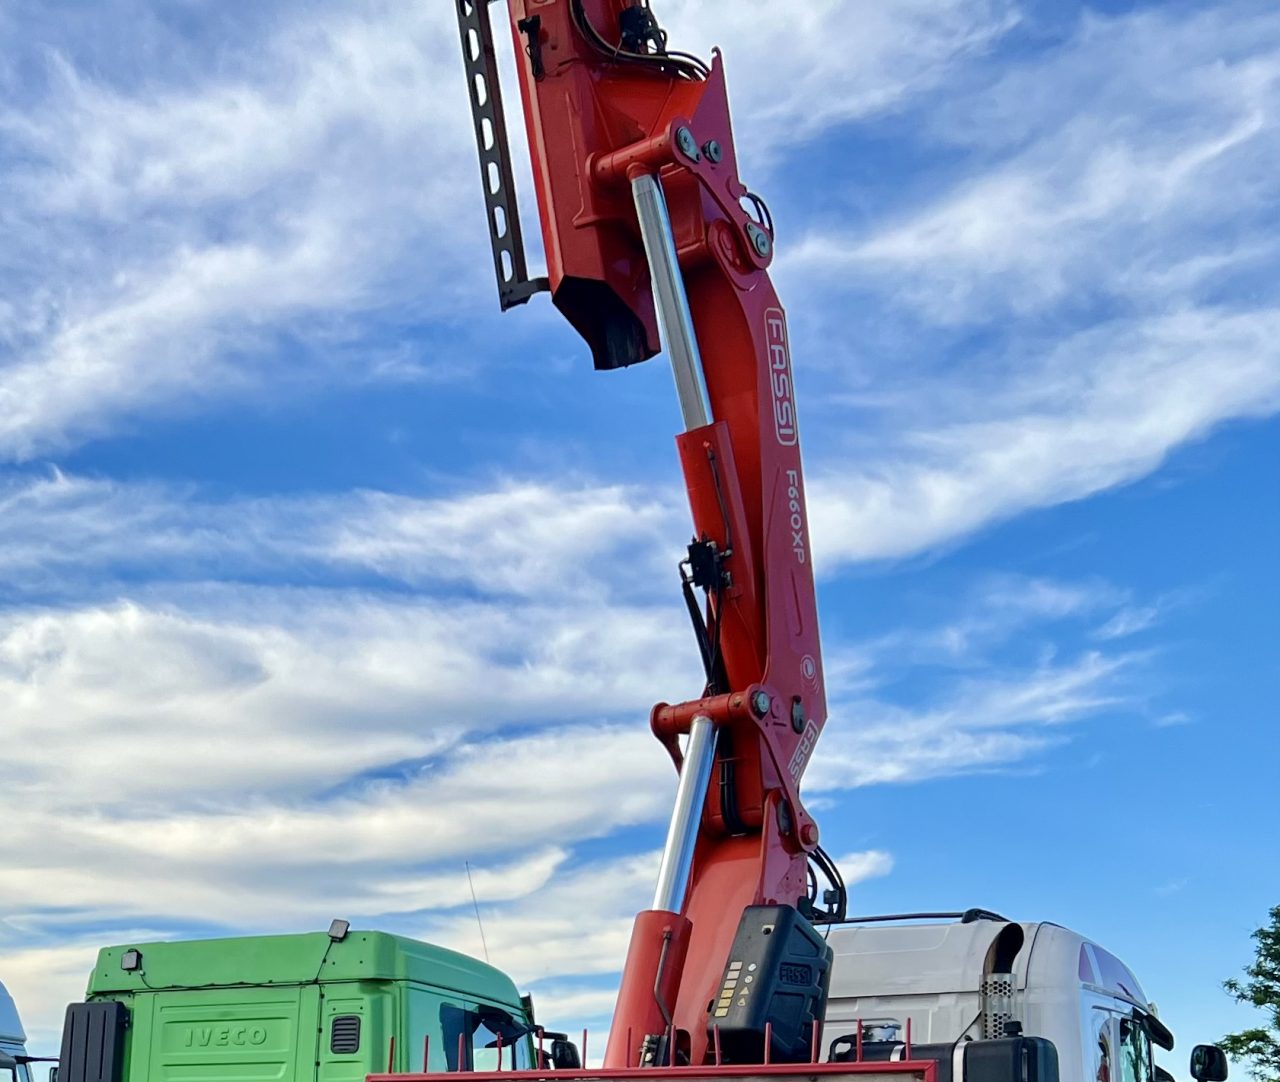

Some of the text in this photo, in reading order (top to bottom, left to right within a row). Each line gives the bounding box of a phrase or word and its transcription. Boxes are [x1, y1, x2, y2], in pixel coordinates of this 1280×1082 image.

[768, 318, 794, 435] FASSI
[786, 470, 805, 564] F660XP
[185, 1027, 267, 1047] IVECO
